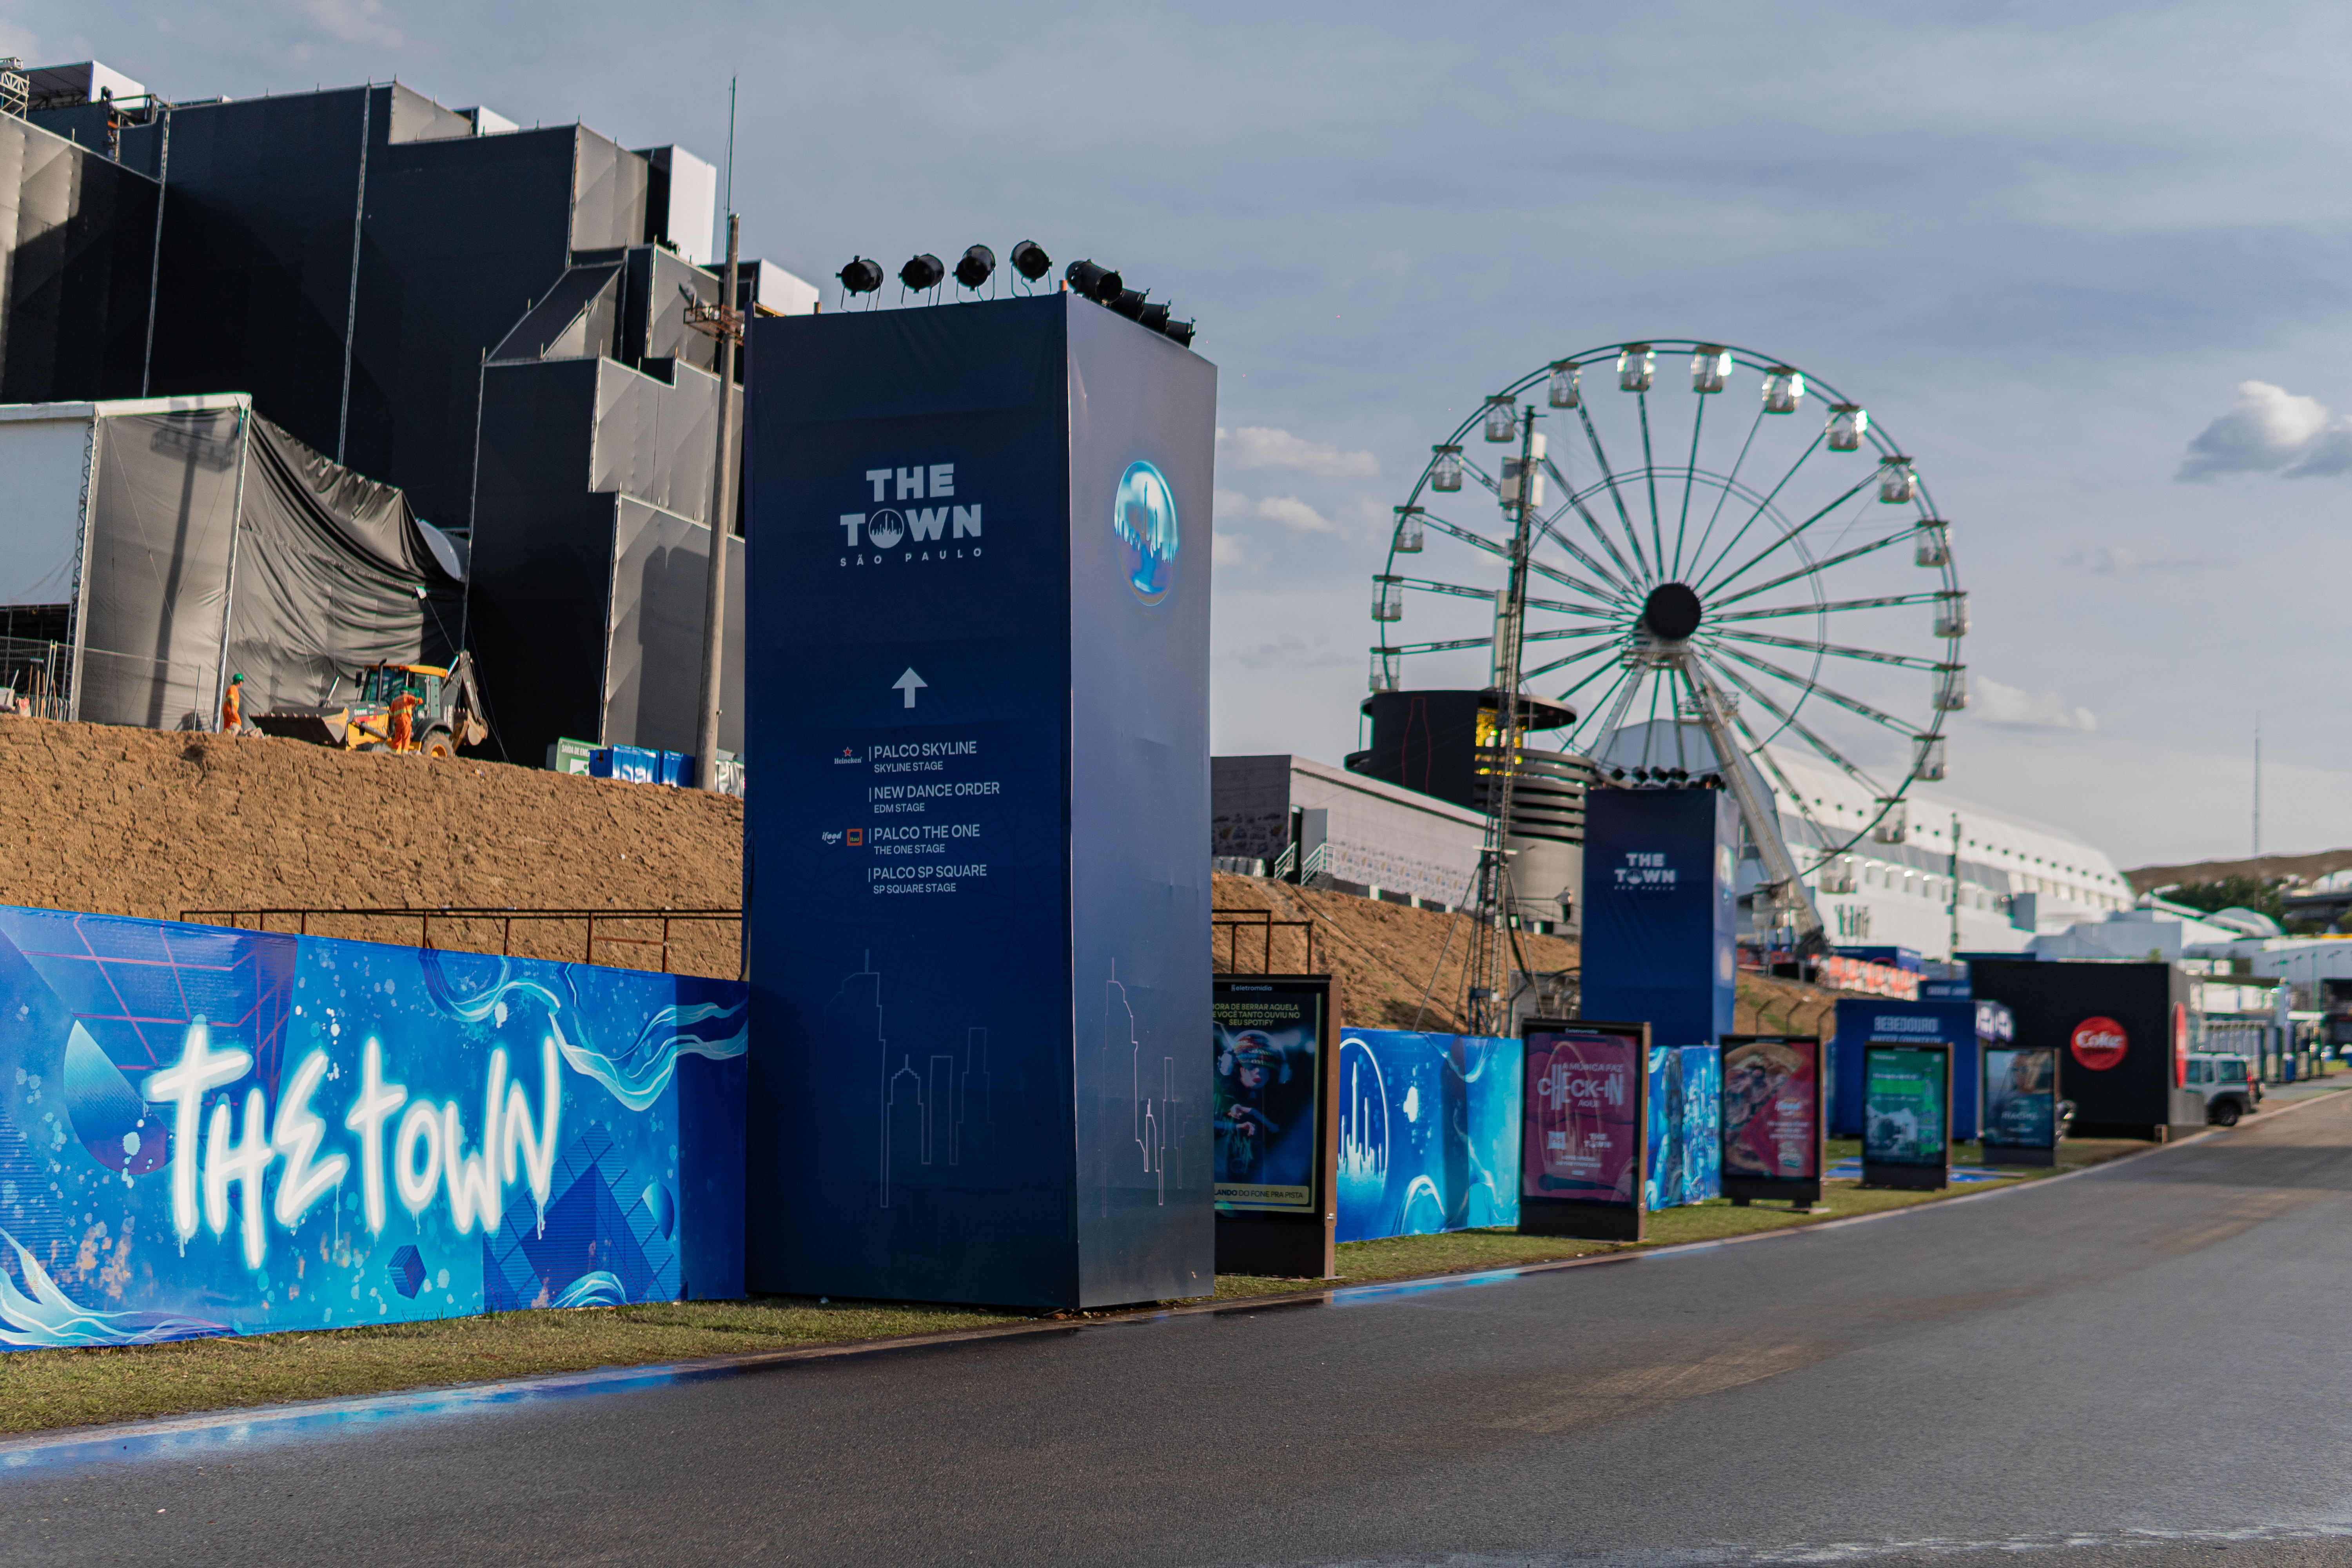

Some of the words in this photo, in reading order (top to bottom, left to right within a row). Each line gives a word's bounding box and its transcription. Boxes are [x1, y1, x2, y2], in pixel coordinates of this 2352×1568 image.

[866, 463, 954, 502] THE
[840, 504, 981, 548] TOWN
[840, 554, 882, 567] SÃO
[905, 548, 982, 562] PAULO
[562, 742, 573, 754] SAÍDA
[574, 746, 580, 755] DE
[874, 744, 920, 759] PALCO
[922, 741, 977, 756] SKYLINE
[874, 762, 911, 773] SKYLINE
[913, 761, 943, 772] STAGE
[874, 786, 905, 799] NEW
[907, 784, 953, 798] DANCE
[955, 782, 1000, 796] ORDER
[874, 804, 894, 813] EDM
[895, 803, 925, 813] STAGE
[874, 827, 920, 840] PALCO
[923, 826, 949, 839] THE
[951, 824, 980, 838] ONE
[874, 846, 892, 855] THE
[893, 845, 913, 854] ONE
[915, 844, 945, 854] STAGE
[1626, 853, 1664, 867] THE
[873, 866, 915, 880] PALCO
[918, 866, 933, 878] SP
[936, 864, 987, 878] SQUARE
[873, 885, 885, 894] SP
[887, 884, 924, 894] SQUARE
[926, 883, 956, 893] STAGE
[1218, 1010, 1237, 1018] VOCÊ
[2075, 1030, 2123, 1048] Coke
[1537, 1064, 1624, 1110] CHECK-IN
[143, 1014, 350, 1269] THE
